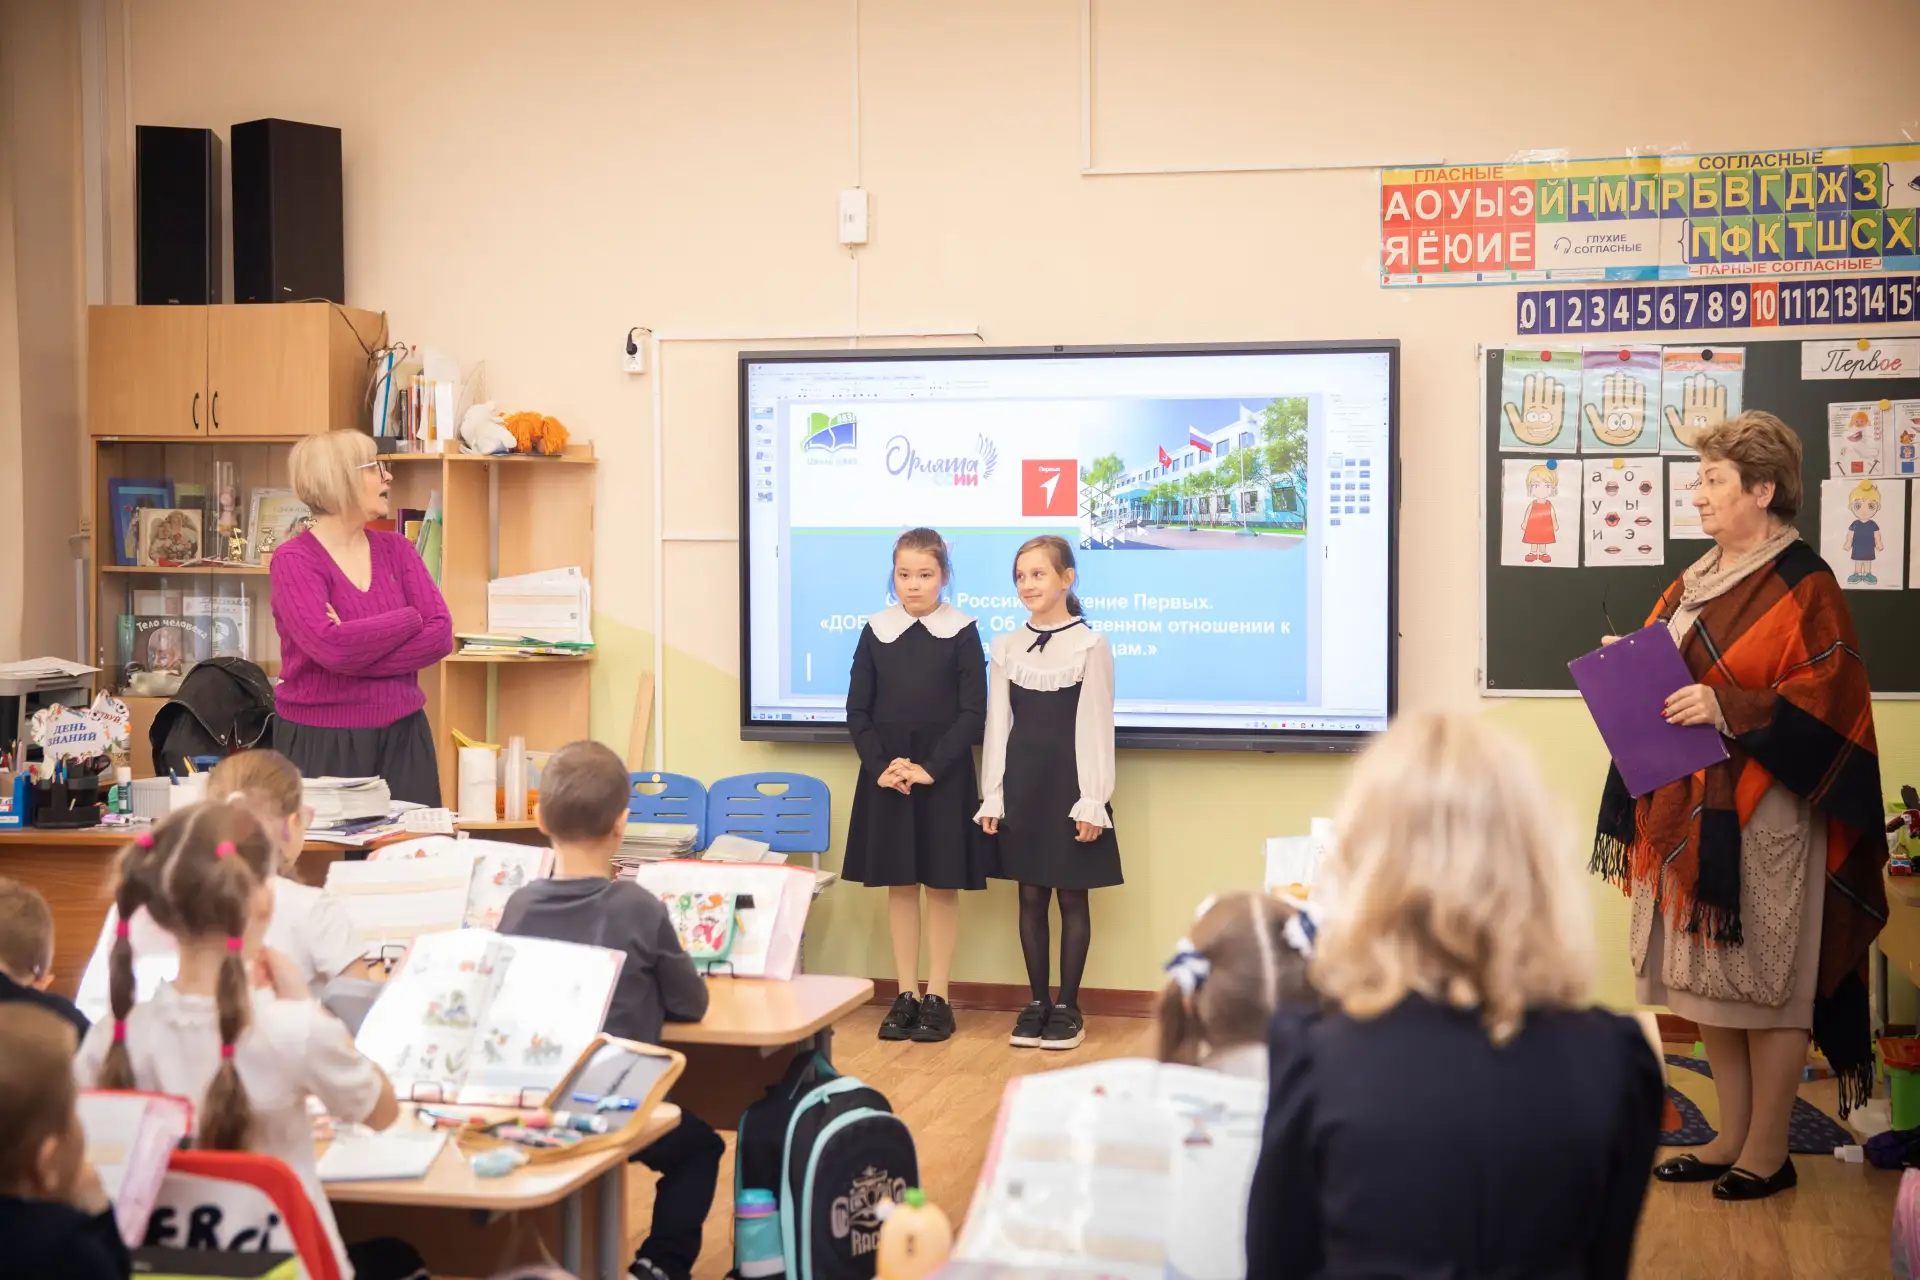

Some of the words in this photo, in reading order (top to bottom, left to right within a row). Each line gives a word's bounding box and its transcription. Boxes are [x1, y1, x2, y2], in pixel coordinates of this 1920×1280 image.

[1698, 151, 1823, 170] СОГЛАСНЫЕ
[1414, 167, 1504, 182] ГЛАСНЫЕ
[1586, 234, 1627, 243] ГЛУХИЕ
[1574, 243, 1642, 254] СОГЛАСНЫЕ
[1699, 263, 1766, 275] ПАРНЫЕ
[1771, 258, 1872, 272] СОГЛАСНЫЕ
[1520, 298, 1536, 329] 0
[1546, 298, 1556, 327] 1
[1568, 297, 1582, 326] 2
[1590, 296, 1605, 326] 3
[1614, 296, 1629, 325] 4
[1636, 294, 1651, 324] 5
[1660, 294, 1676, 323] 6
[1684, 293, 1699, 322] 7
[1707, 292, 1723, 322] 8
[1730, 290, 1746, 321] 9
[1754, 290, 1775, 320] 10
[1782, 288, 1801, 319] 11
[1806, 287, 1830, 318] 12
[1834, 286, 1857, 317] 13
[1861, 284, 1885, 316] 14
[1889, 284, 1912, 315] 15
[1821, 349, 1902, 379] Первое
[1592, 471, 1602, 482] а
[1592, 500, 1602, 515] у
[1625, 500, 1639, 510] ы
[1592, 529, 1603, 540] и
[1624, 529, 1635, 540] э
[1134, 593, 1214, 613] Первых.
[990, 615, 1015, 631] Об
[1168, 620, 1275, 633] отношении
[1280, 621, 1291, 633] к
[53, 723, 87, 735] ДЕНЬ
[47, 732, 97, 746] ЗНАНИЙ
